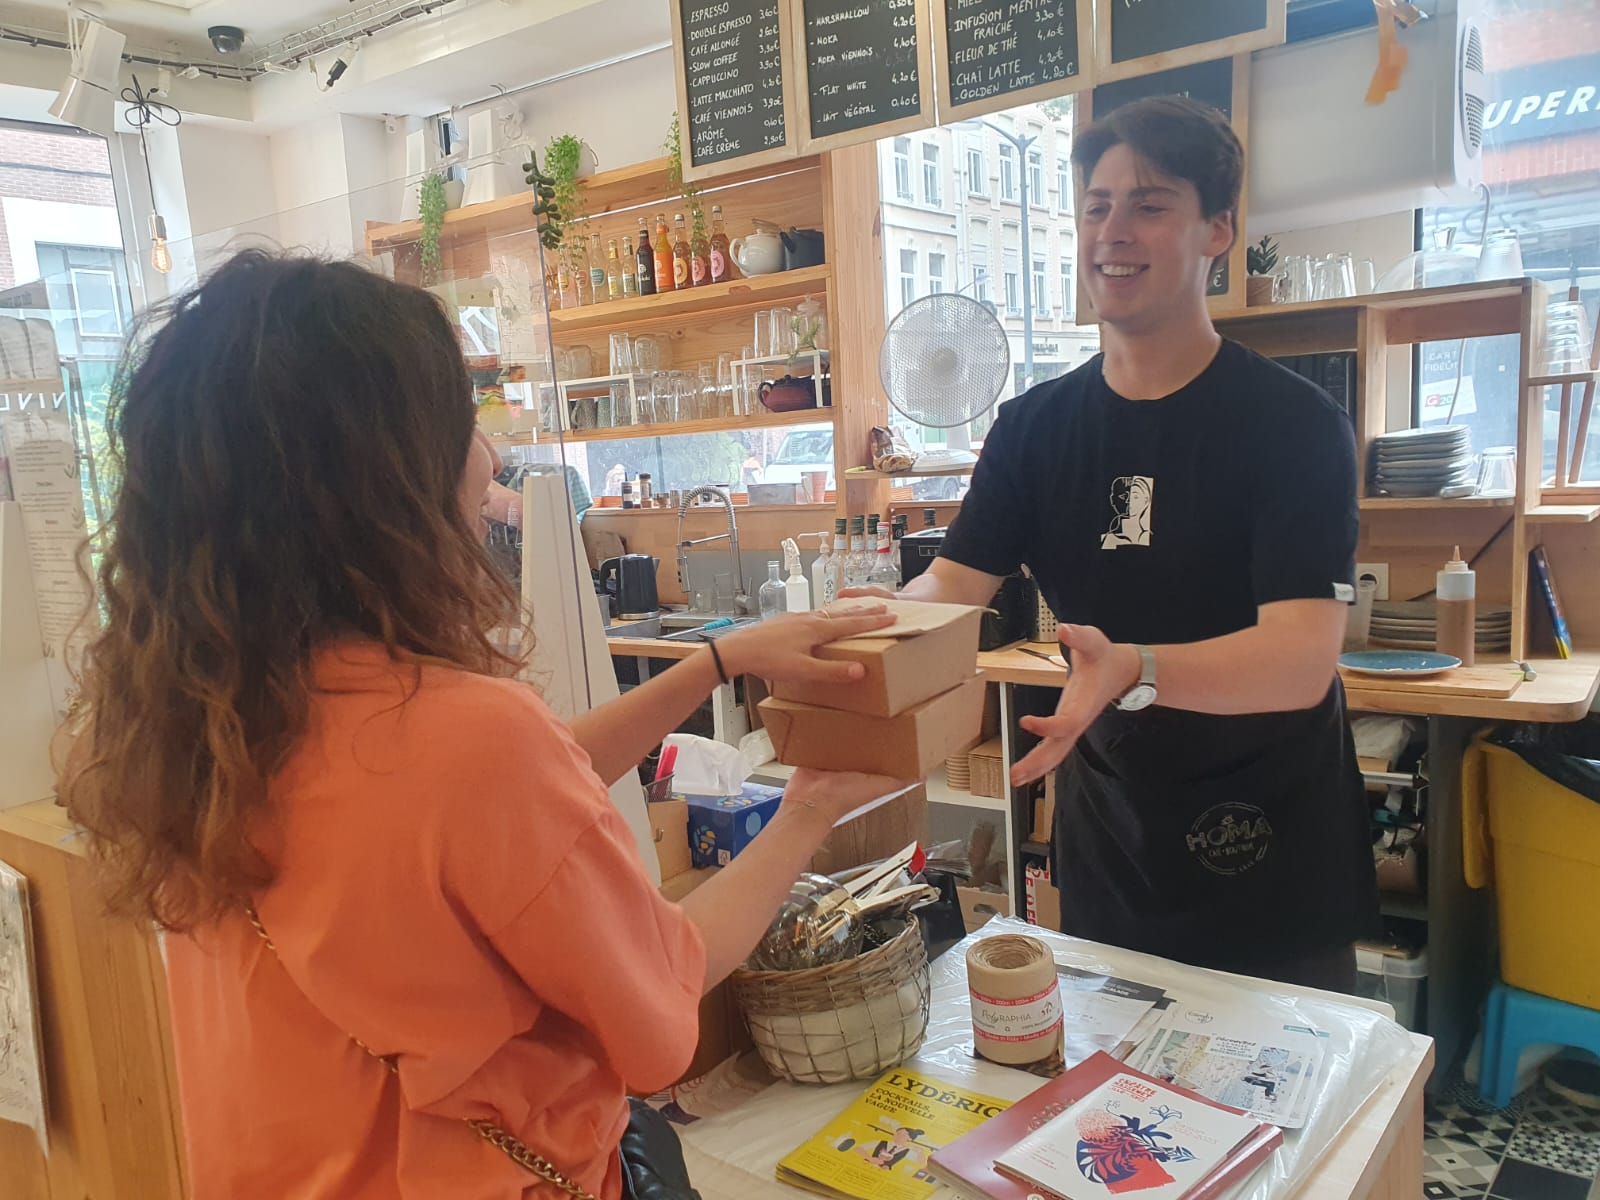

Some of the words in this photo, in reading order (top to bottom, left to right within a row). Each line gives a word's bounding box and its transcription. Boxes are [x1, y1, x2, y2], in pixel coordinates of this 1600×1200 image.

[691, 2, 729, 23] ESPRESSO
[815, 5, 870, 26] MARSHMALLOW
[954, 8, 1002, 33] INFUSION
[690, 25, 717, 41] DOUBLE
[718, 14, 752, 34] ESPRESSO
[973, 19, 1014, 40] FRAICHE
[690, 40, 708, 57] CAFÉ
[710, 32, 740, 53] ALLONGÉ
[816, 34, 838, 46] MOKA
[955, 45, 984, 65] FLEUR
[988, 42, 999, 56] DE
[1001, 31, 1018, 51] THÉ
[692, 60, 711, 73] SLOW
[713, 51, 739, 67] COFFEE
[817, 55, 836, 65] MOKA
[841, 46, 873, 61] VIENNOIS
[692, 68, 739, 87] CAPPUCCINO
[956, 65, 983, 87] CHAÏ
[988, 59, 1021, 81] LATTE
[693, 93, 713, 107] LATTE
[714, 83, 754, 102] MACCHIATO
[819, 84, 841, 96] FLAT
[846, 80, 867, 91] WHITE
[960, 82, 1000, 100] GOLDEN
[1009, 72, 1036, 88] LATTE
[694, 107, 711, 124] CAFÉ
[714, 101, 753, 120] VIENNOIS
[823, 111, 839, 122] LAIT
[843, 101, 877, 118] VÉGÉTAL
[1482, 85, 1600, 130] UPER
[696, 125, 725, 143] ARÔME
[697, 141, 714, 157] CAFÉ
[716, 138, 741, 154] CRÈME
[864, 1097, 898, 1114] VAGUE
[868, 1092, 883, 1101] LA
[885, 1098, 936, 1120] NOUVELLE
[886, 1074, 1003, 1118] LYDÉRIC
